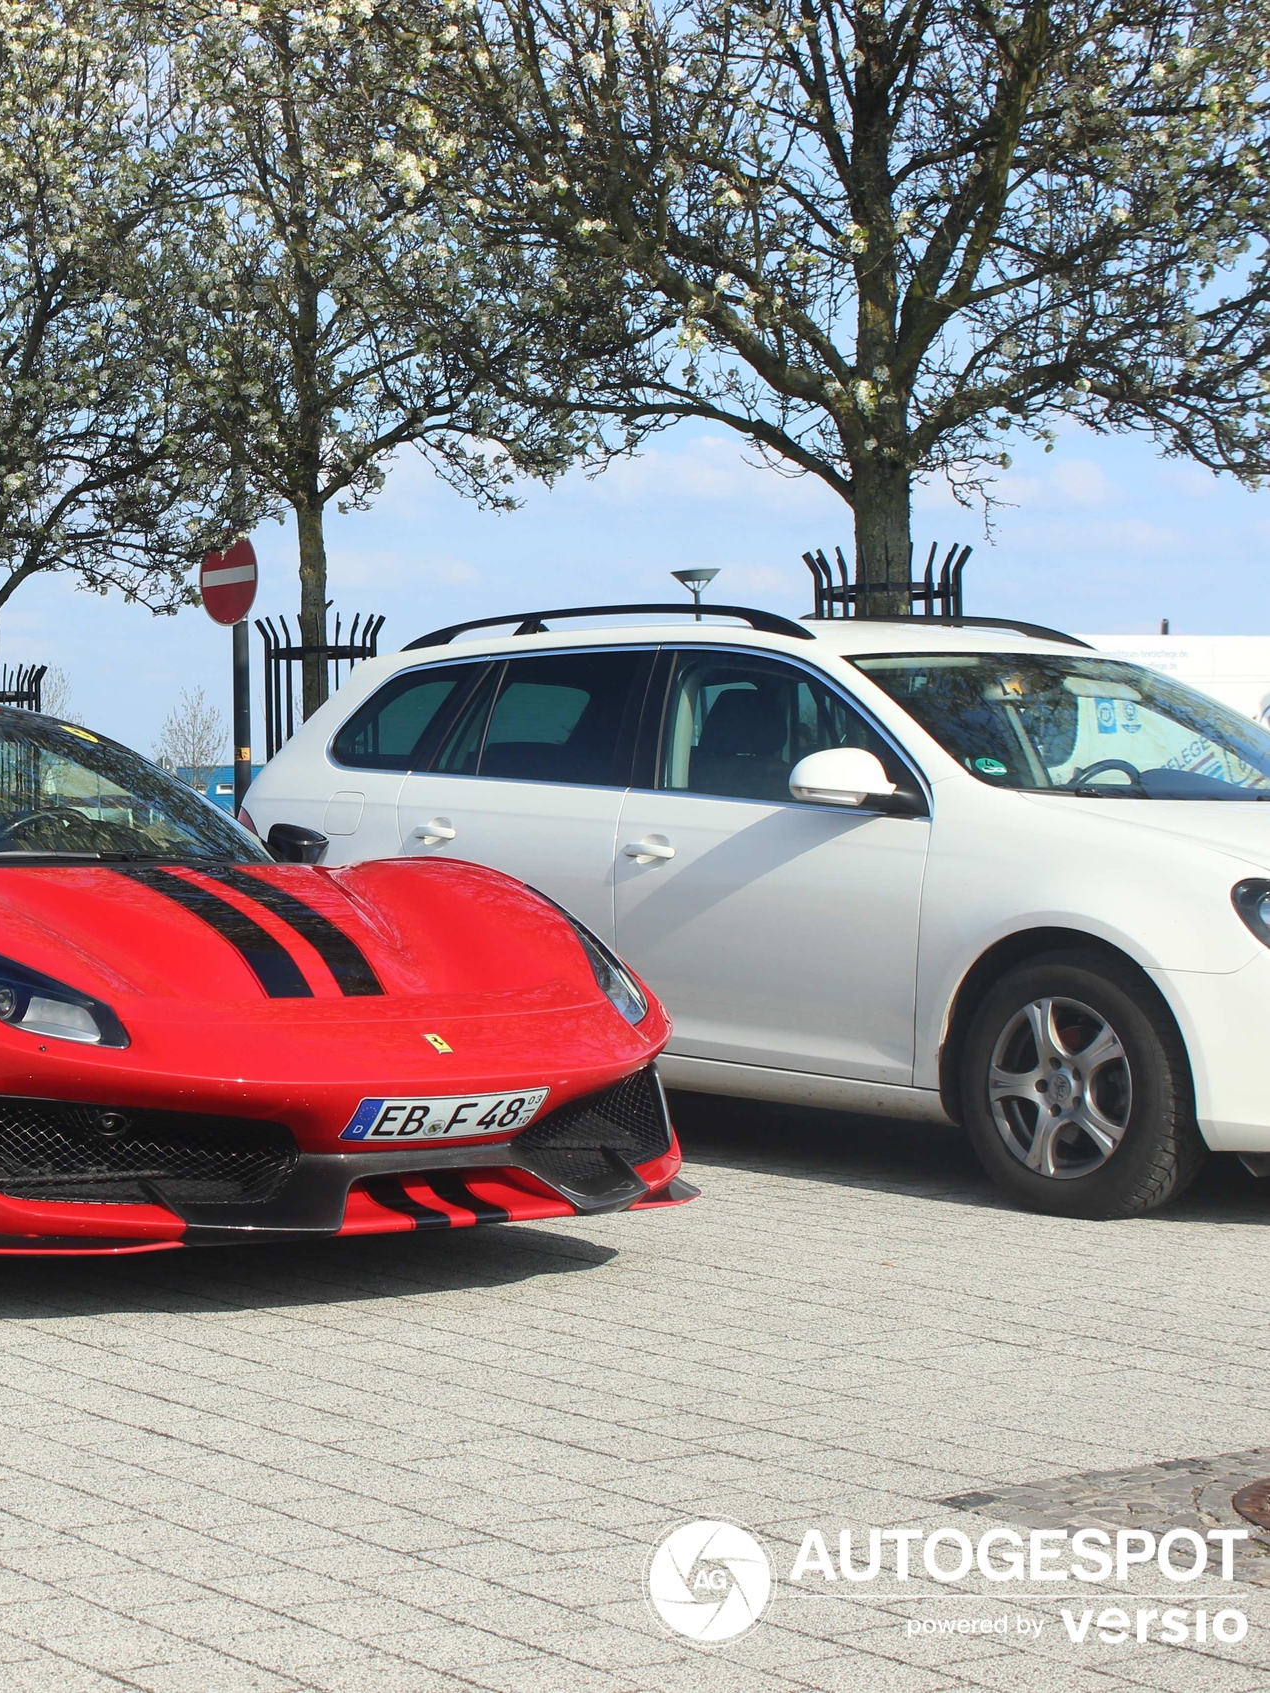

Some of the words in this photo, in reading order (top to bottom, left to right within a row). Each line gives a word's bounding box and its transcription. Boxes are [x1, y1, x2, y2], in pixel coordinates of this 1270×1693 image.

[527, 1094, 543, 1106] 03
[371, 1105, 430, 1136] EB
[443, 1102, 478, 1134] F
[476, 1097, 526, 1132] 48
[517, 1115, 531, 1126] 10
[352, 1124, 364, 1134] D
